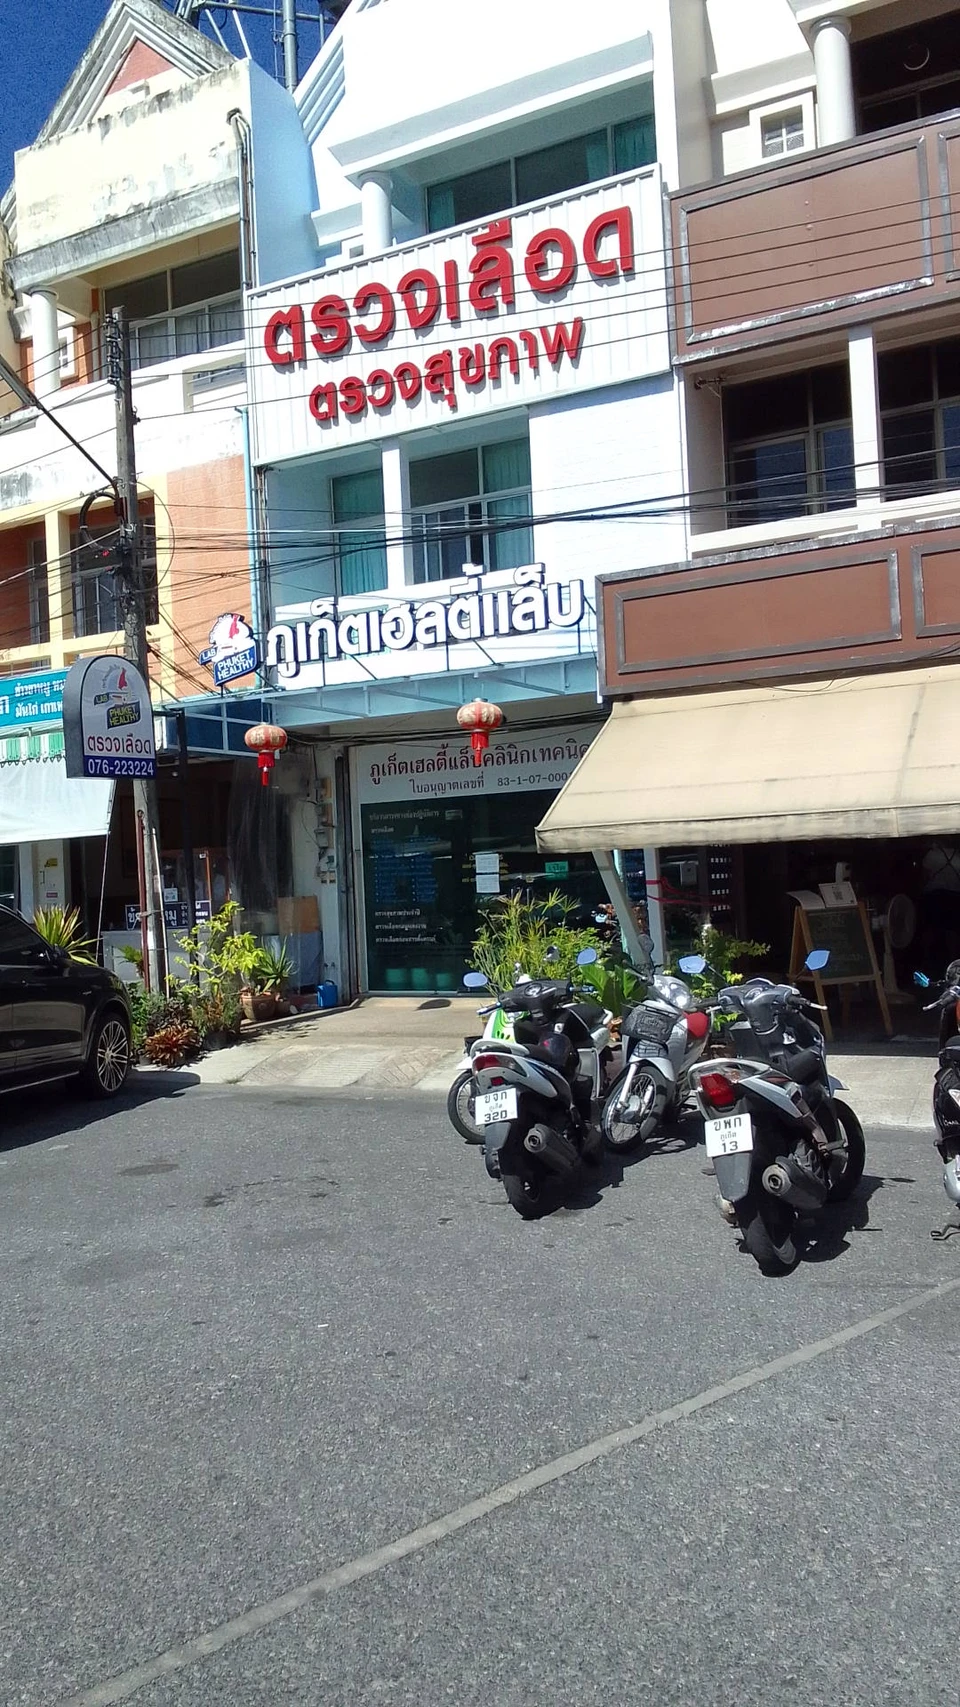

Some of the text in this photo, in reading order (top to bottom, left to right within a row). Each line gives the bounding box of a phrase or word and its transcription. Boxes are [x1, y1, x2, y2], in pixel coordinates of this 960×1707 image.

[264, 205, 635, 366] ตรวจเลือด
[309, 316, 584, 421] ตรวจสุขภาพ
[266, 562, 585, 679] ภูเก็ตเฮลตี้แล็บ
[202, 648, 217, 660] LAB
[217, 649, 252, 672] PHUKET
[217, 657, 255, 681] HEALTHY
[95, 694, 109, 703] LAB
[109, 704, 137, 718] PHUKET
[110, 711, 140, 727] HEALTHY
[87, 732, 152, 755] ตรวจเลือด
[87, 758, 154, 776] 076-223224
[484, 1091, 508, 1104] ขจก
[484, 1109, 508, 1123] 320
[713, 1116, 742, 1131] ขพก
[721, 1140, 739, 1153] 13
